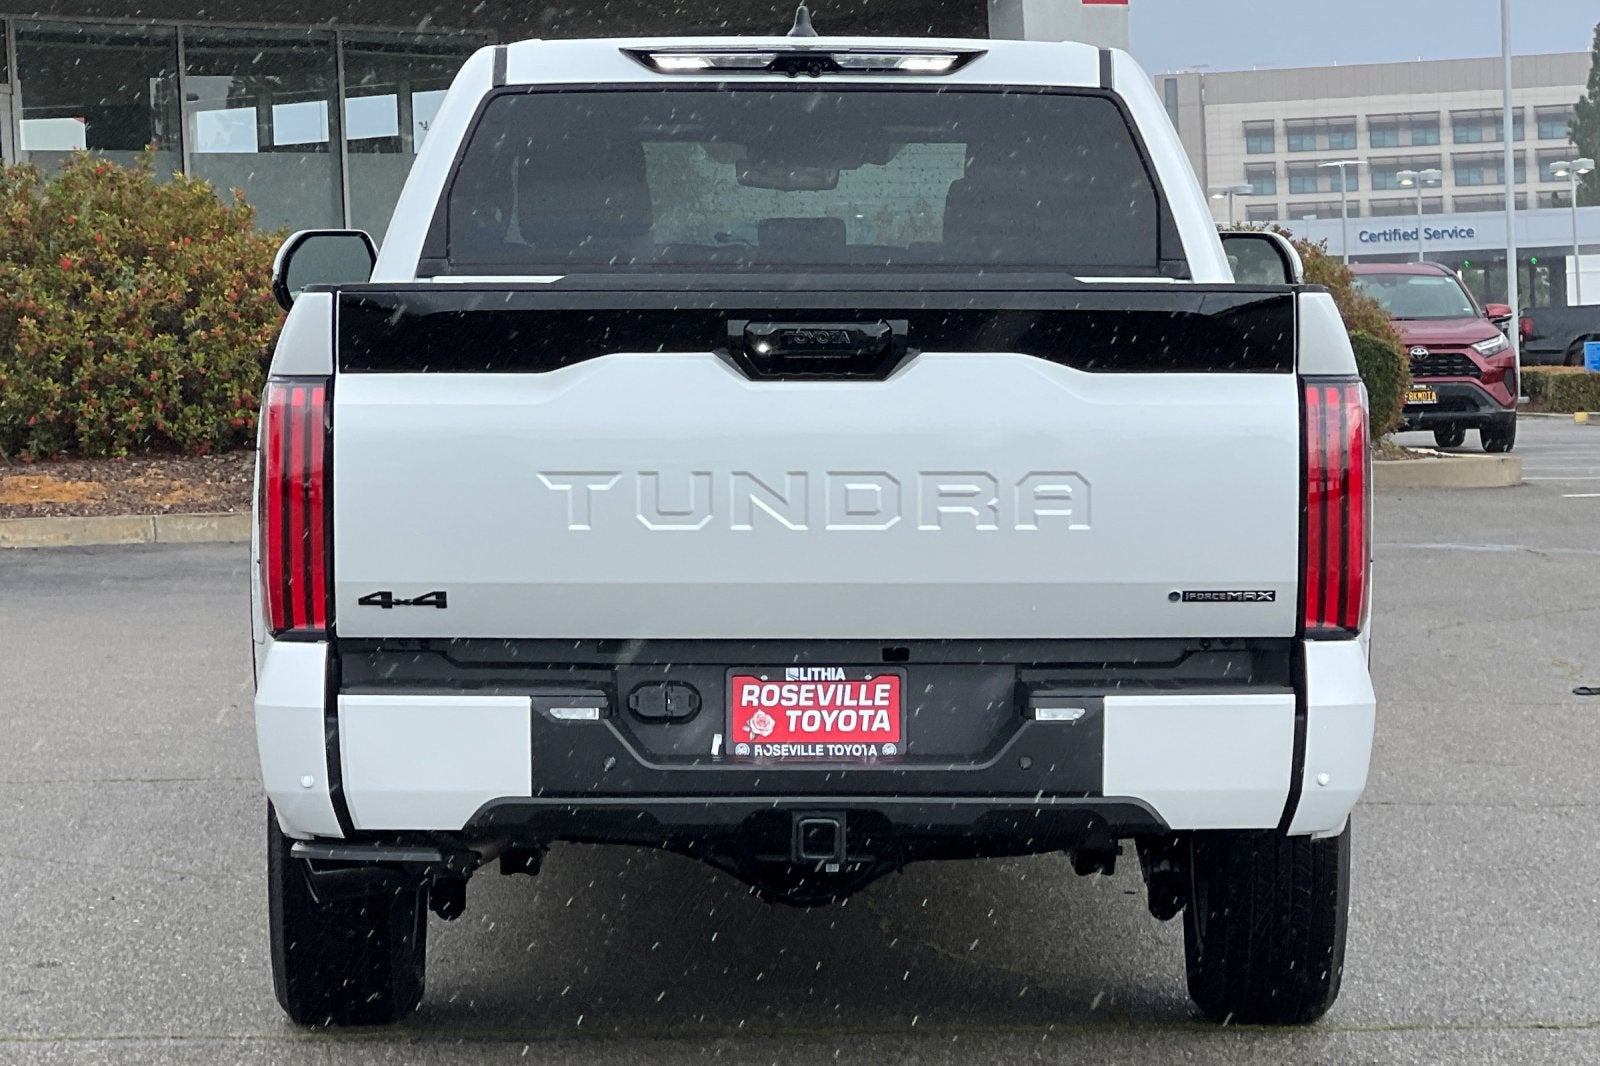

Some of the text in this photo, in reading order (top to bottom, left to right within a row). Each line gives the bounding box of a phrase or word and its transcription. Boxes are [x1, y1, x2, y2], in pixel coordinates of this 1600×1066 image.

[1359, 226, 1475, 242] Certified Service
[537, 471, 1092, 531] TUNDRA
[799, 667, 846, 681] LITHIA
[741, 684, 891, 707] ROSEVILLE
[785, 709, 891, 732] TOYOTA
[754, 744, 878, 756] ROSEVILLE TOYOTA
